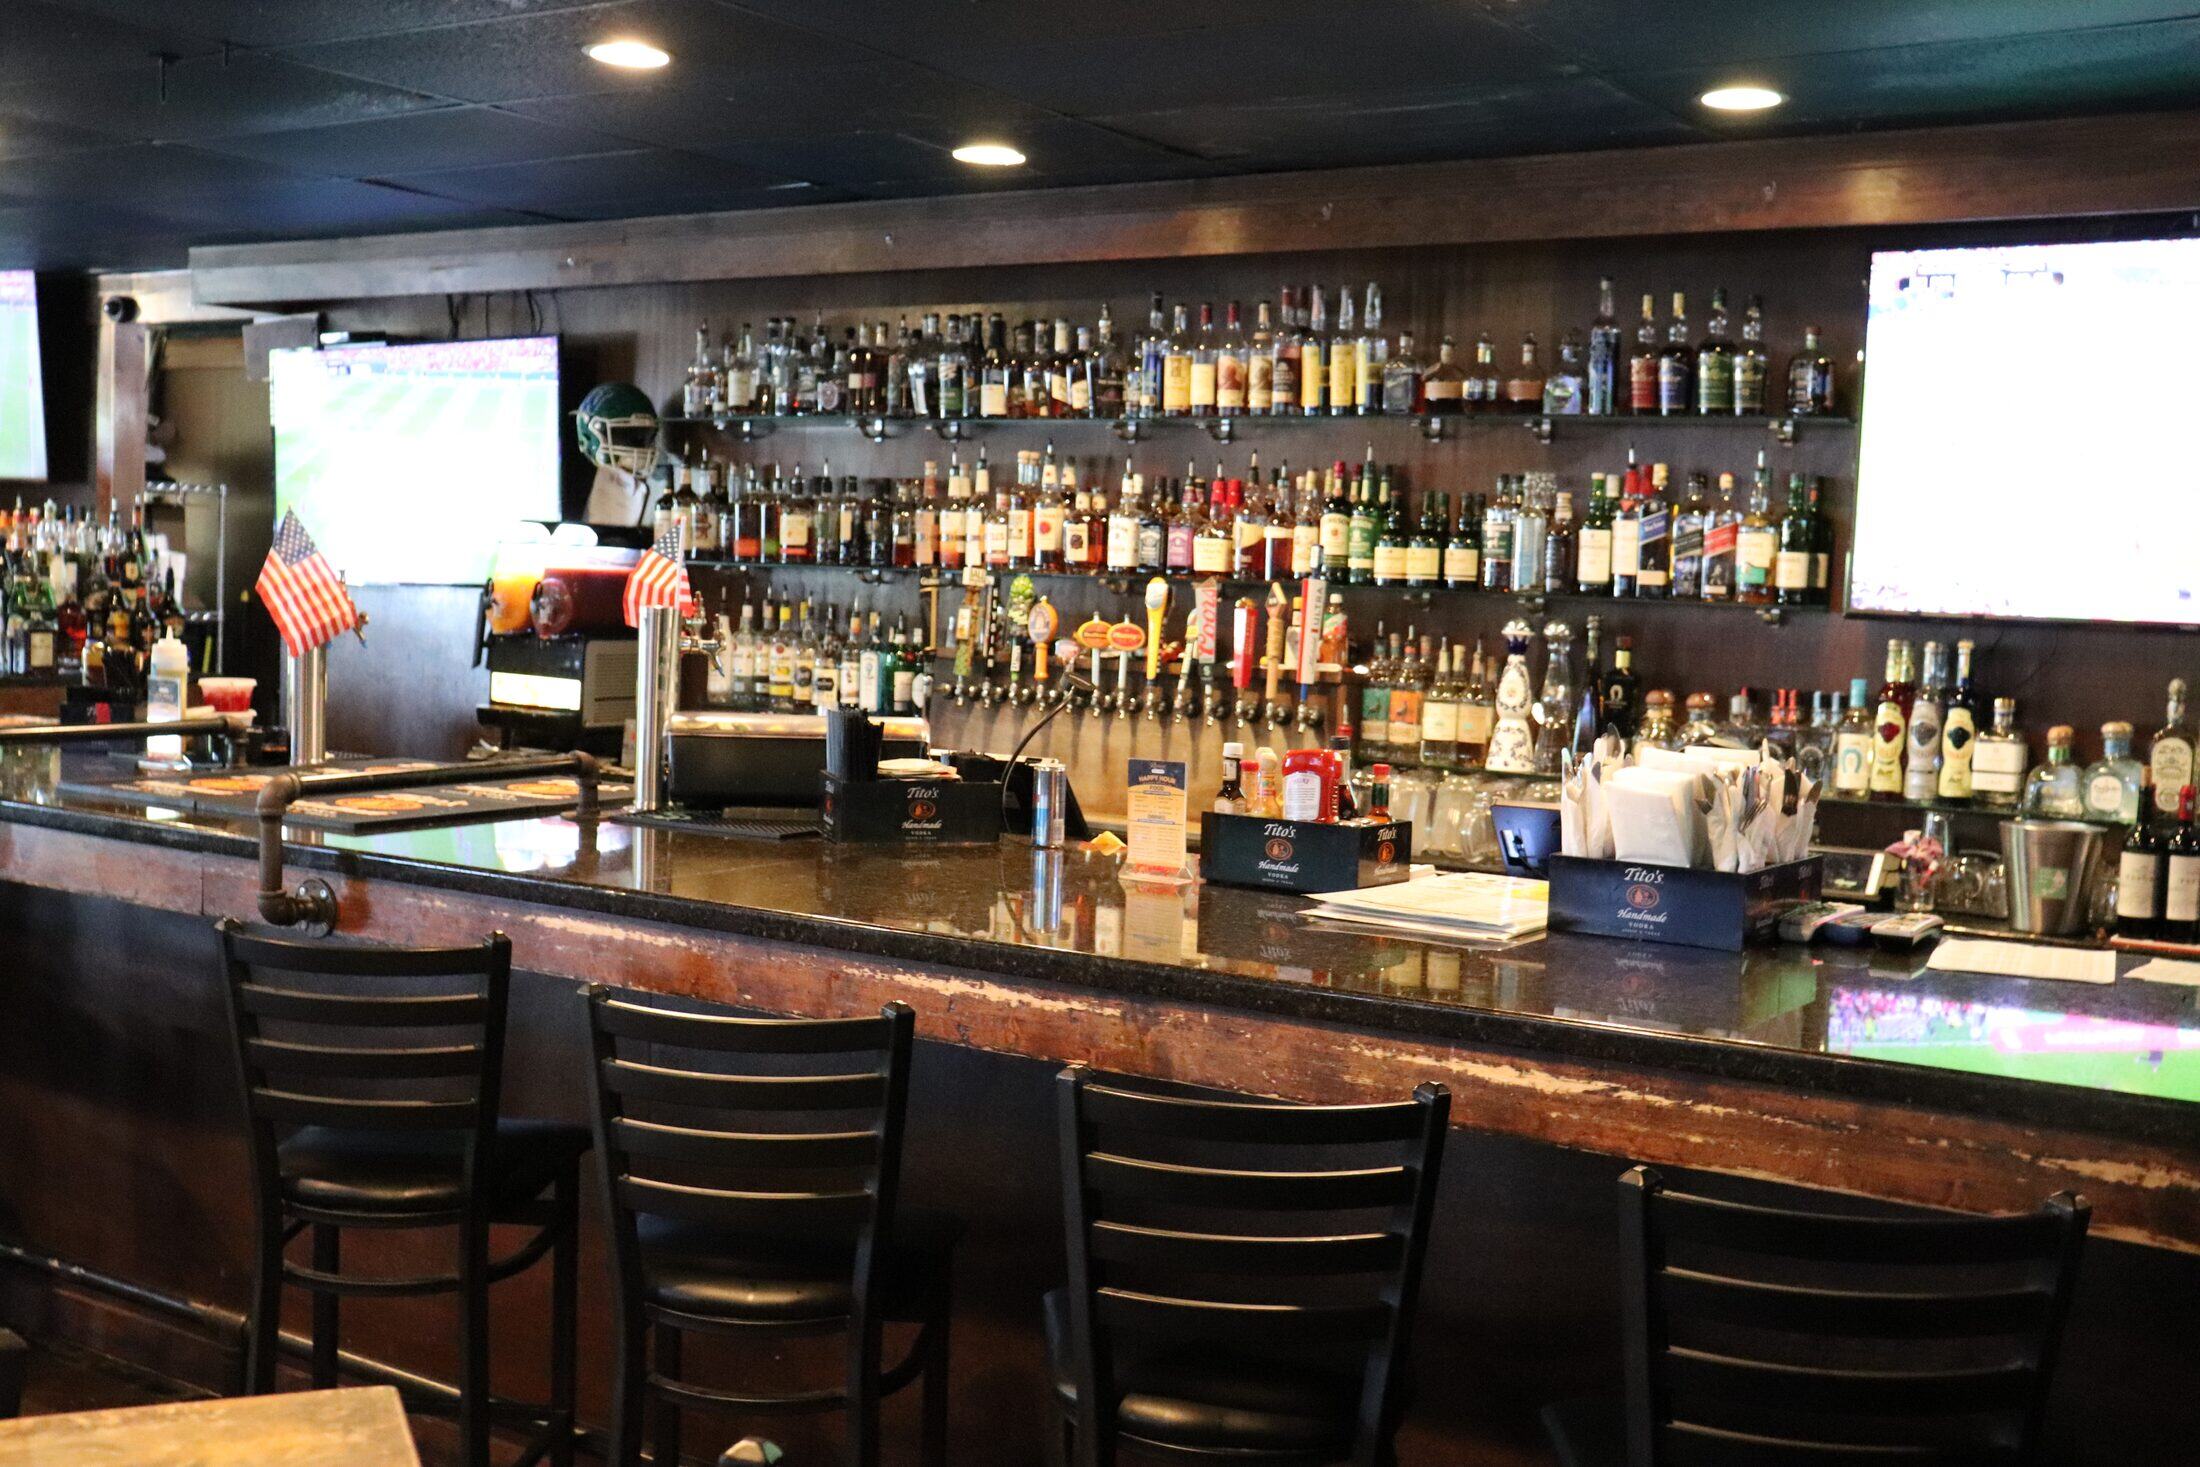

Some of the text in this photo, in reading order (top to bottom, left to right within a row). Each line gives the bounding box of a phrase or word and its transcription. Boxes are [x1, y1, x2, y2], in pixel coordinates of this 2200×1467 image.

[1197, 588, 1217, 656] Coors
[907, 786, 939, 799] Tito's
[1264, 823, 1296, 838] Tito's
[1258, 859, 1299, 873] Handmade
[1623, 867, 1664, 884] Tito's
[1617, 908, 1667, 923] Handmade
